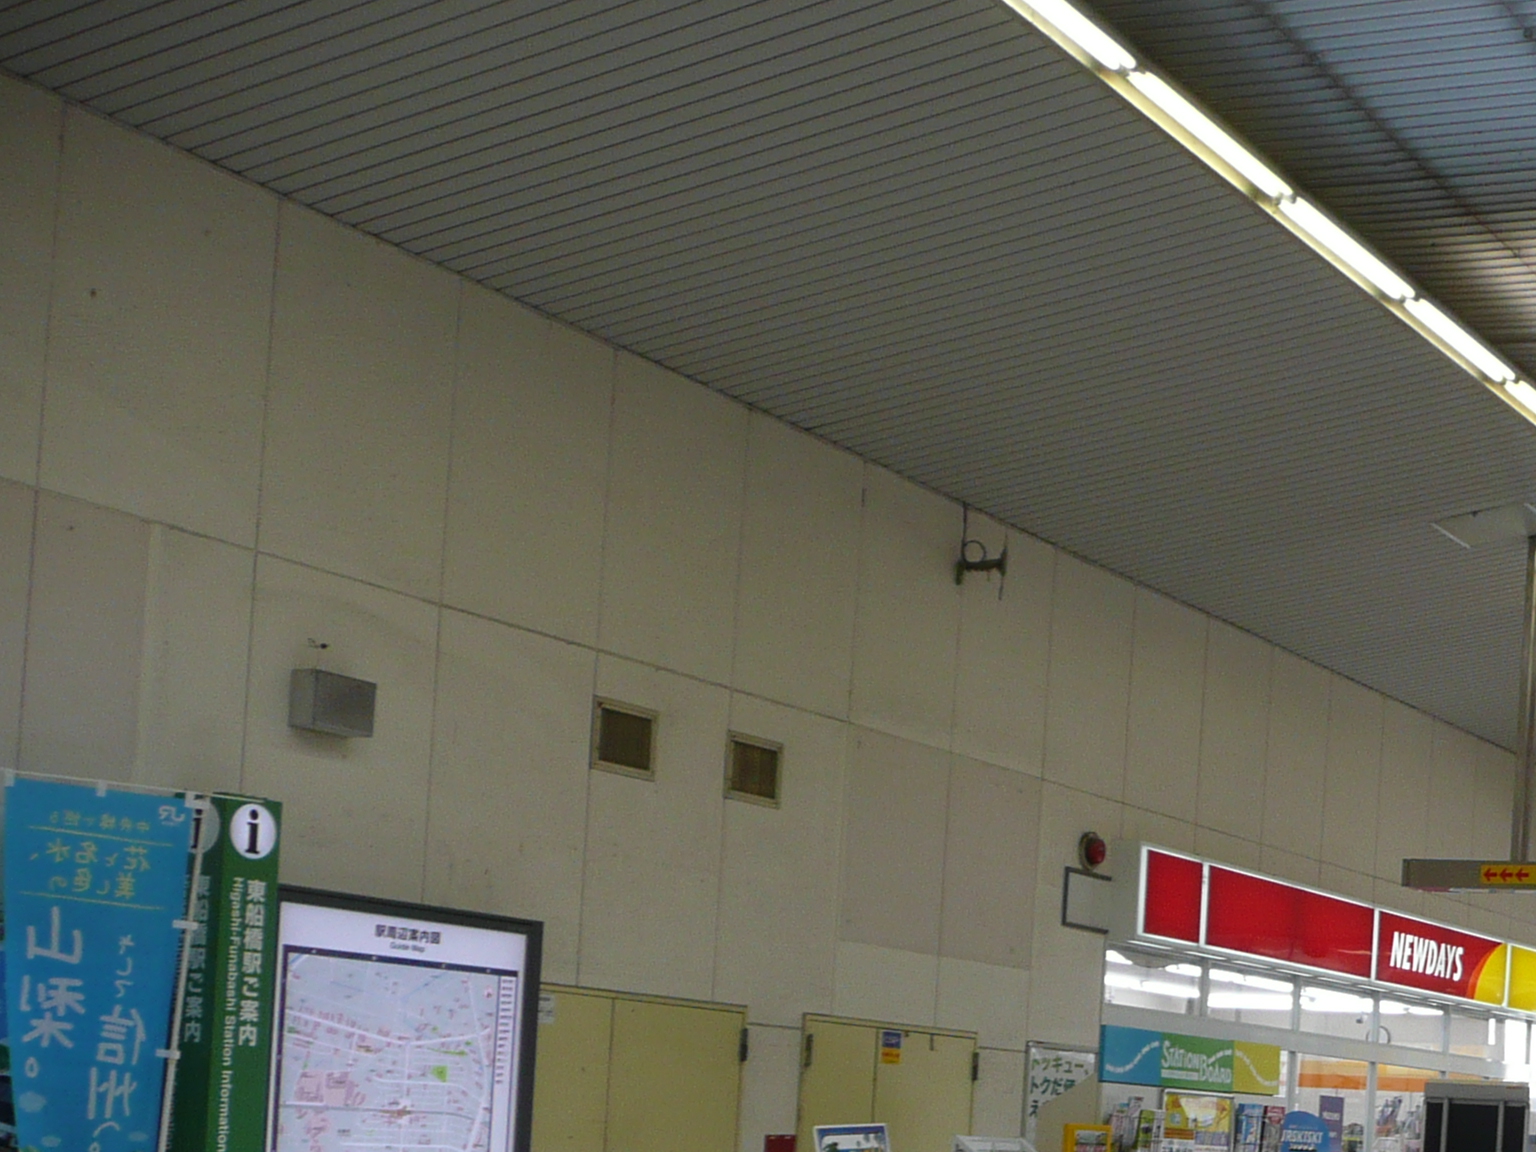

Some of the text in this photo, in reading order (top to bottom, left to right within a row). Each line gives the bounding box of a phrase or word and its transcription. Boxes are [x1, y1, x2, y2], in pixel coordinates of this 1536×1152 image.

[224, 876, 245, 1014] Higashi-Funabashi
[375, 923, 441, 945] 駅周辺案内図
[1390, 931, 1465, 982] NEWDAYS
[238, 877, 268, 1048] 東船橋駅ご案内
[221, 1015, 238, 1068] Station
